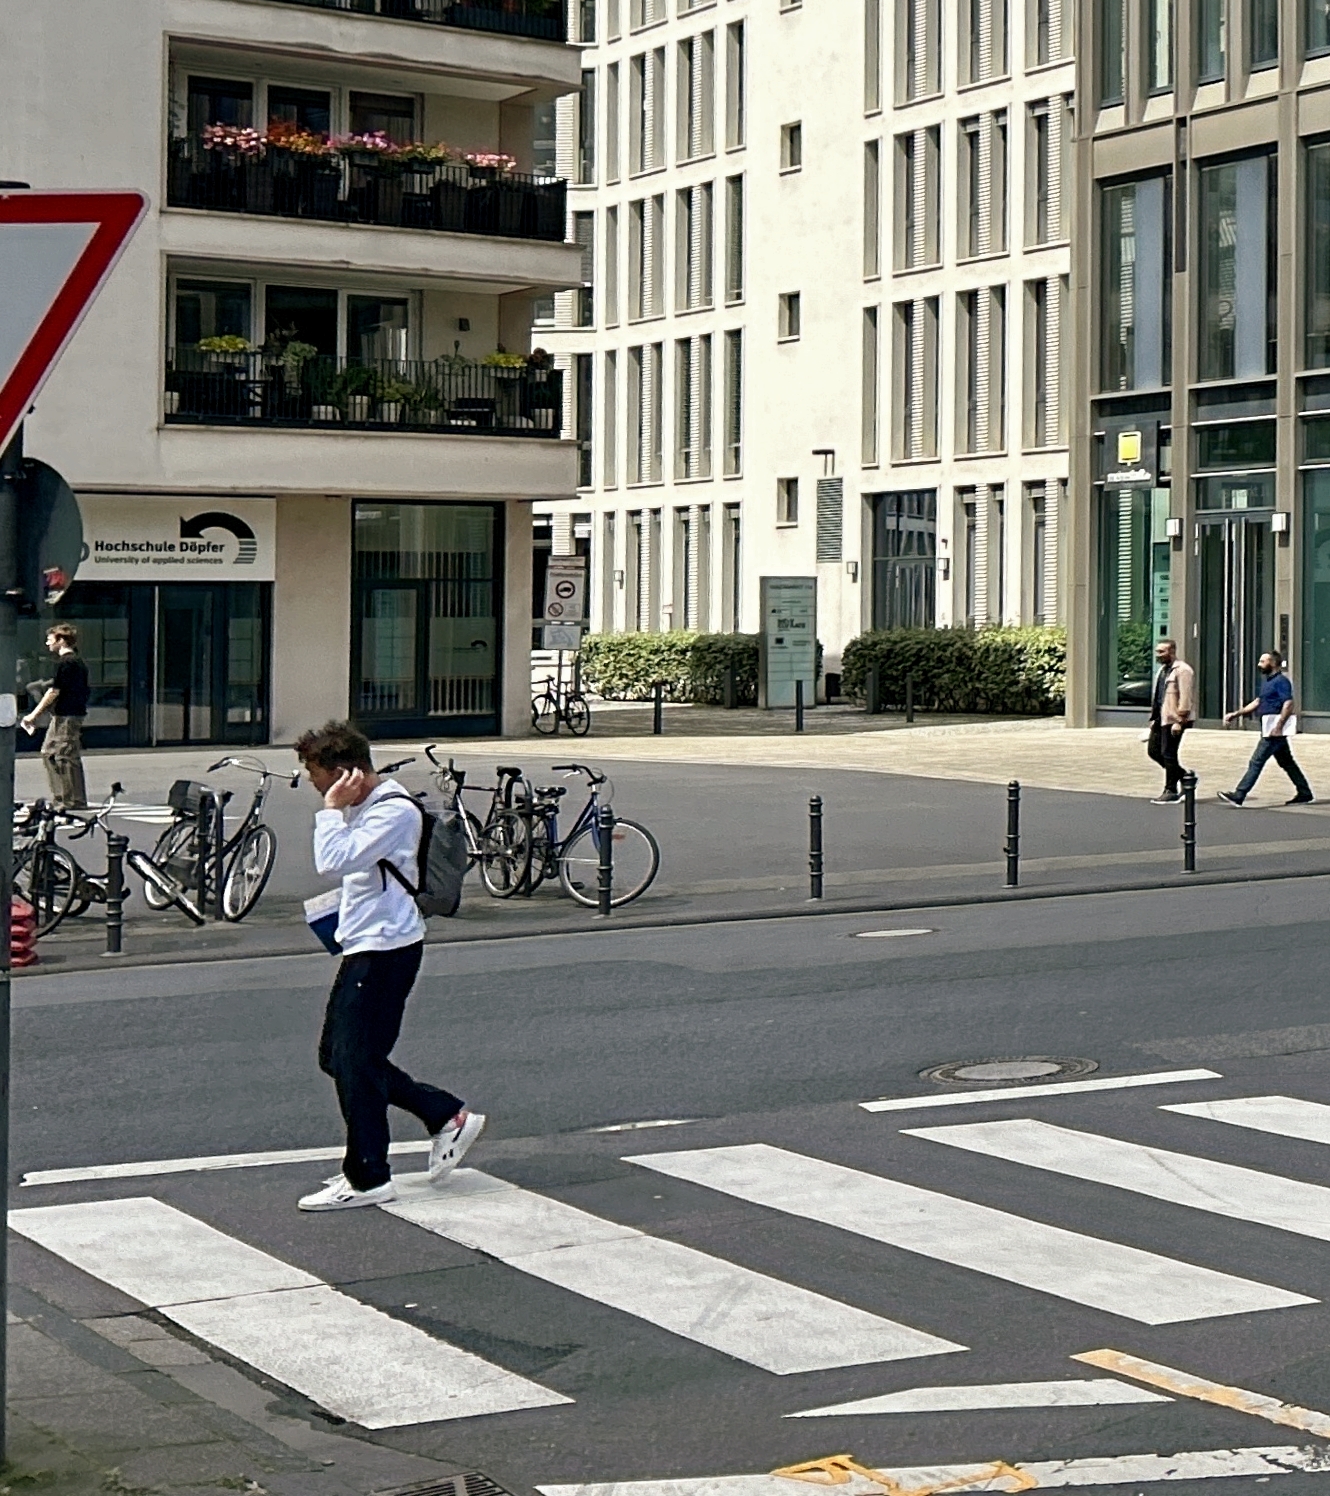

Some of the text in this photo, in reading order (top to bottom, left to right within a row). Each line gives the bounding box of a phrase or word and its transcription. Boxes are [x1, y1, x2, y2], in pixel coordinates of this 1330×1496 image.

[94, 540, 176, 553] Hochschule
[179, 541, 225, 555] Döpfer
[94, 555, 223, 566] University of applied sciences
